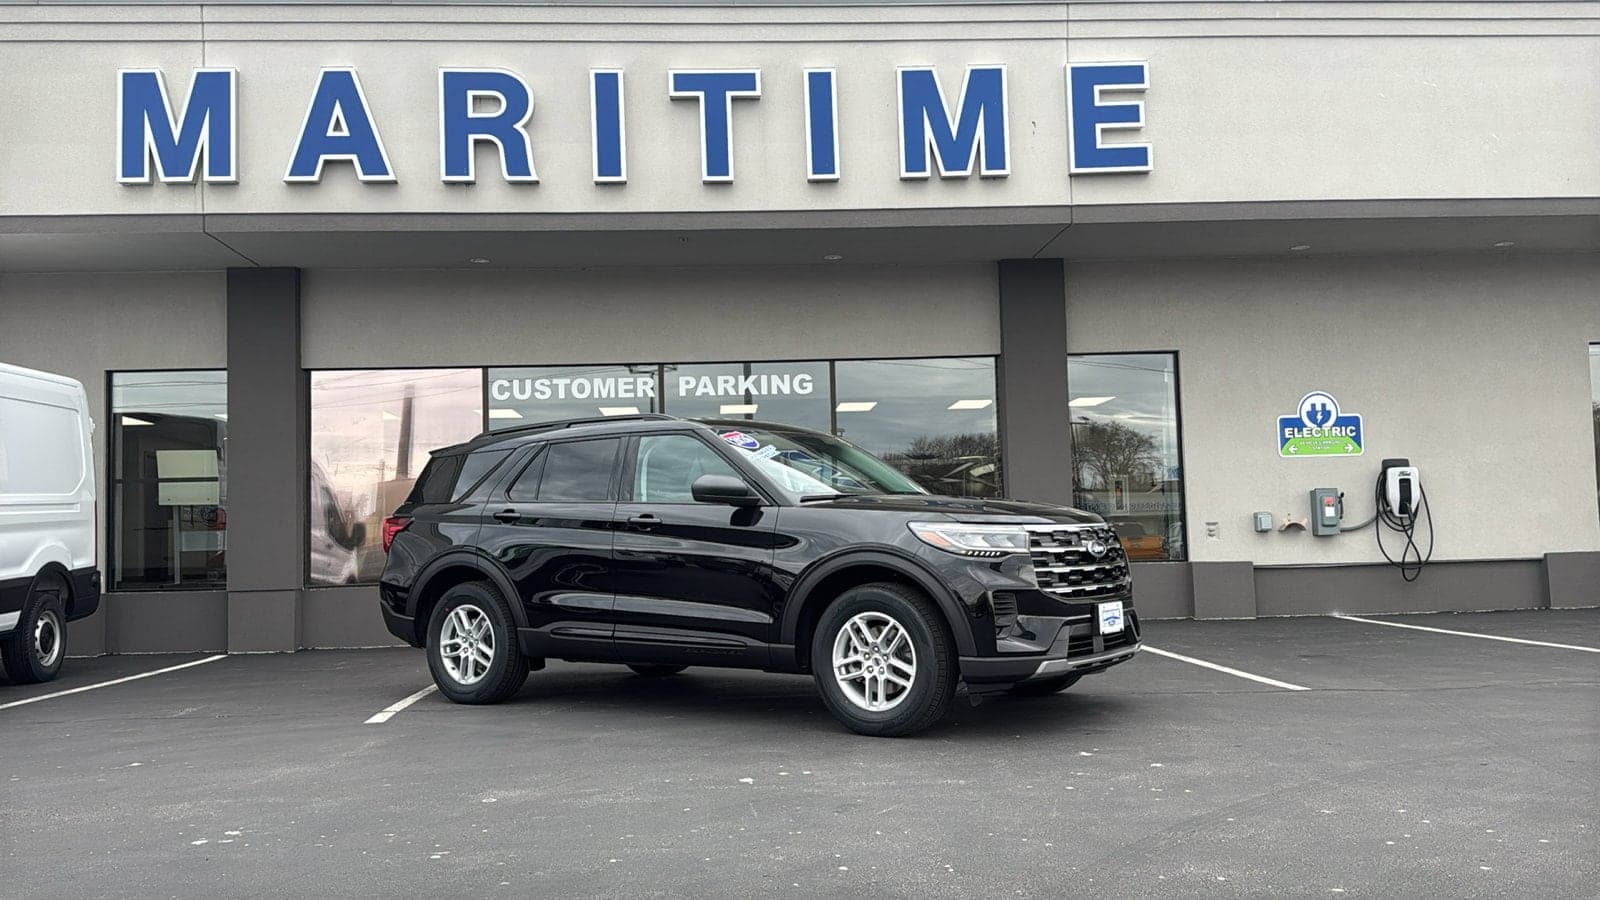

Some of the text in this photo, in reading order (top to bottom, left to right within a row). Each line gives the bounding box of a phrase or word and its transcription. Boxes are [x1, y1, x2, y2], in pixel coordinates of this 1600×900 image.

[116, 61, 1152, 184] MARITIME
[491, 374, 813, 400] CUSTOMER PARKING
[1284, 426, 1356, 438] ELECTRIC
